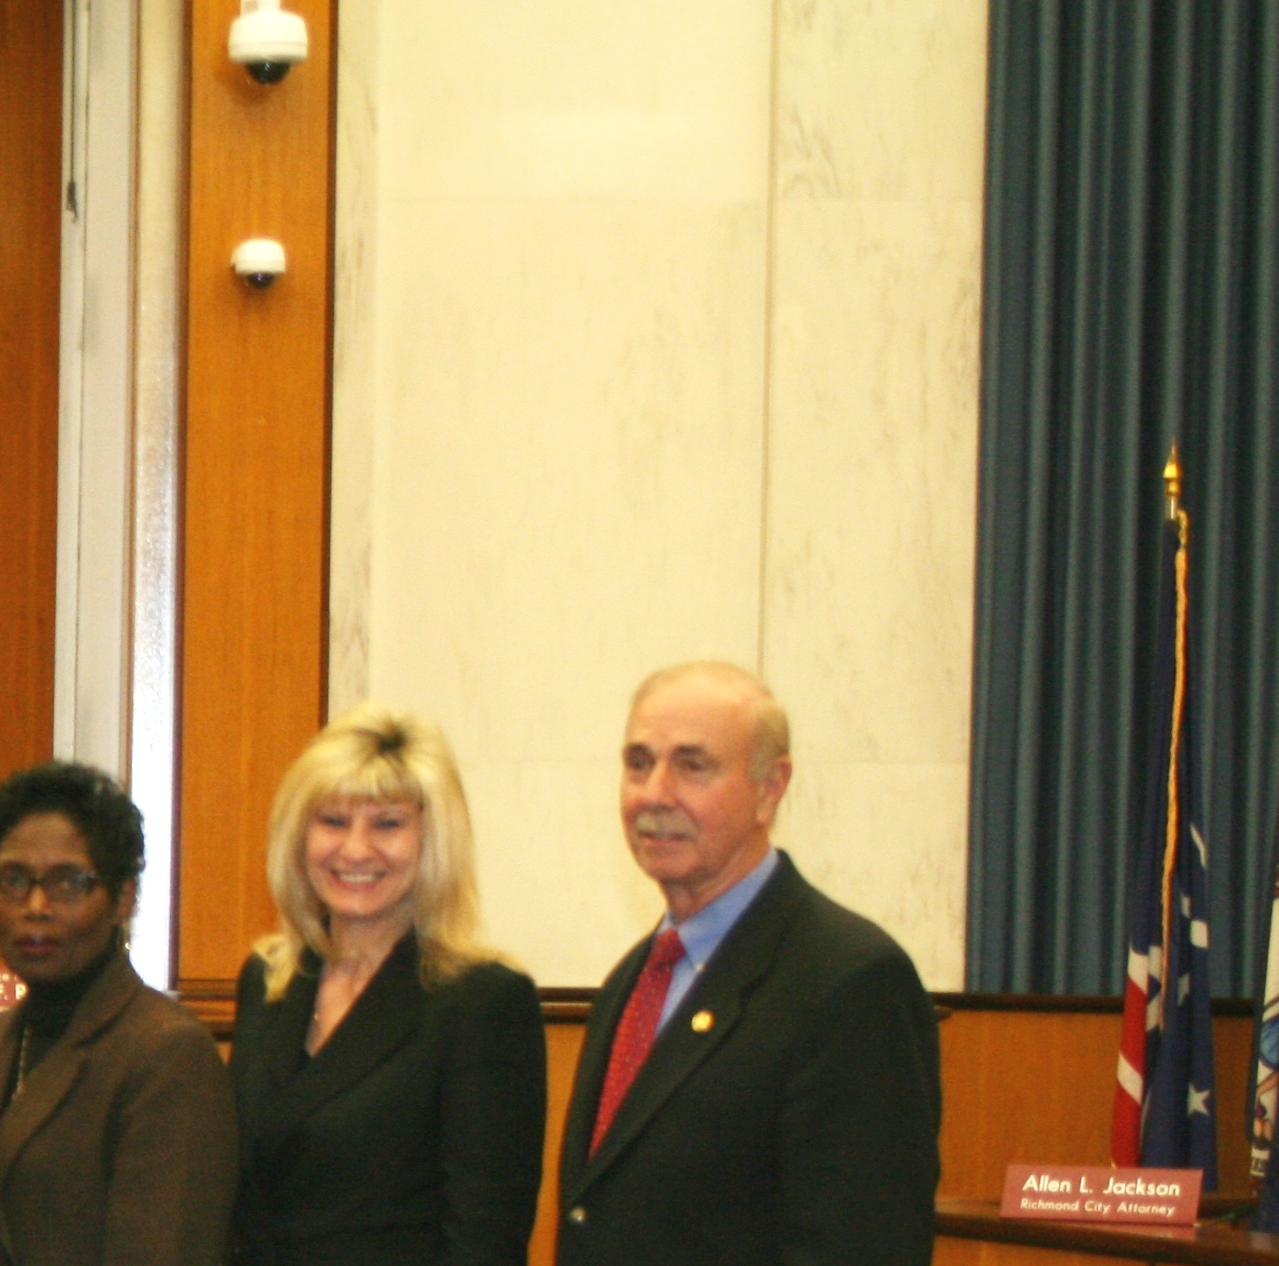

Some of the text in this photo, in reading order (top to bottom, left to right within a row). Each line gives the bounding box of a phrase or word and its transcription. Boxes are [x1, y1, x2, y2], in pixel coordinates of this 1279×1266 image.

[1022, 1174, 1181, 1196] Allen L. Jackson
[1020, 1198, 1176, 1218] Richmond City Attorney
